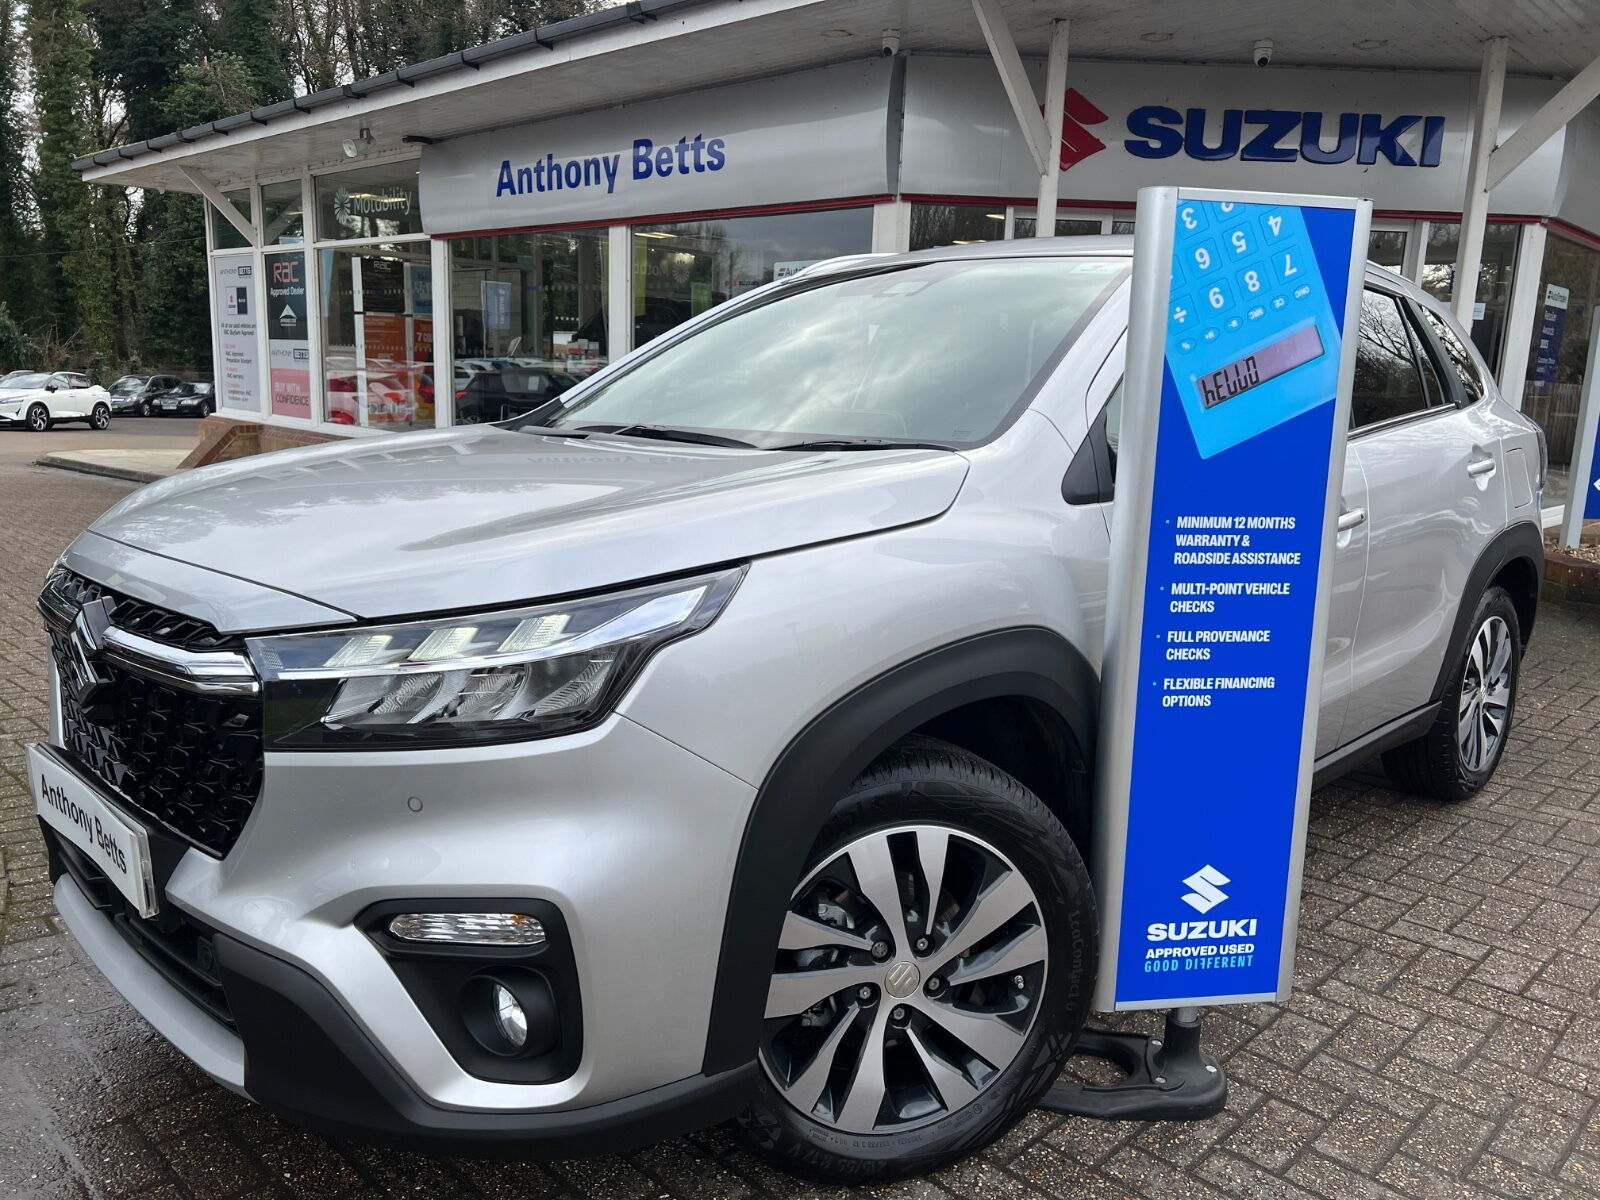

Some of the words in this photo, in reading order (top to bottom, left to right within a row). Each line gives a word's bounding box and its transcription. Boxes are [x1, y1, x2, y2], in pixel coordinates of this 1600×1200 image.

[1124, 105, 1446, 167] SUZUKI
[496, 153, 620, 197] Anthony
[632, 134, 726, 180] Betts
[270, 287, 289, 297] Approved
[290, 286, 304, 296] Dealer
[275, 393, 310, 406] CONFIDENCE
[1176, 516, 1233, 529] MINIMUM
[1234, 516, 1247, 529] 12
[1247, 517, 1296, 529] MONTHS
[1175, 534, 1241, 546] WARRANTY
[1241, 534, 1250, 547] &
[1173, 552, 1231, 564] ROADSIDE
[1231, 552, 1301, 565] ASSISTANCE
[1171, 583, 1245, 595] MULTI-POINT
[1245, 583, 1290, 595] VEHICLE
[1170, 600, 1215, 613] CHECKS
[1167, 630, 1194, 643] FULL
[1195, 630, 1270, 642] PROVENANCE
[1166, 648, 1211, 660] CHECKS
[1163, 677, 1214, 690] FLEXIBLE
[1214, 677, 1275, 689] FINANCING
[1162, 695, 1212, 708] OPTIONS
[41, 773, 94, 844] Anthony
[94, 816, 127, 874] Betts
[1146, 918, 1257, 941] SUZUKI
[1145, 945, 1217, 959] APPROVED
[1219, 943, 1255, 955] USED
[1144, 959, 1179, 973] GOOD
[1185, 955, 1253, 971] DIFFERENT
